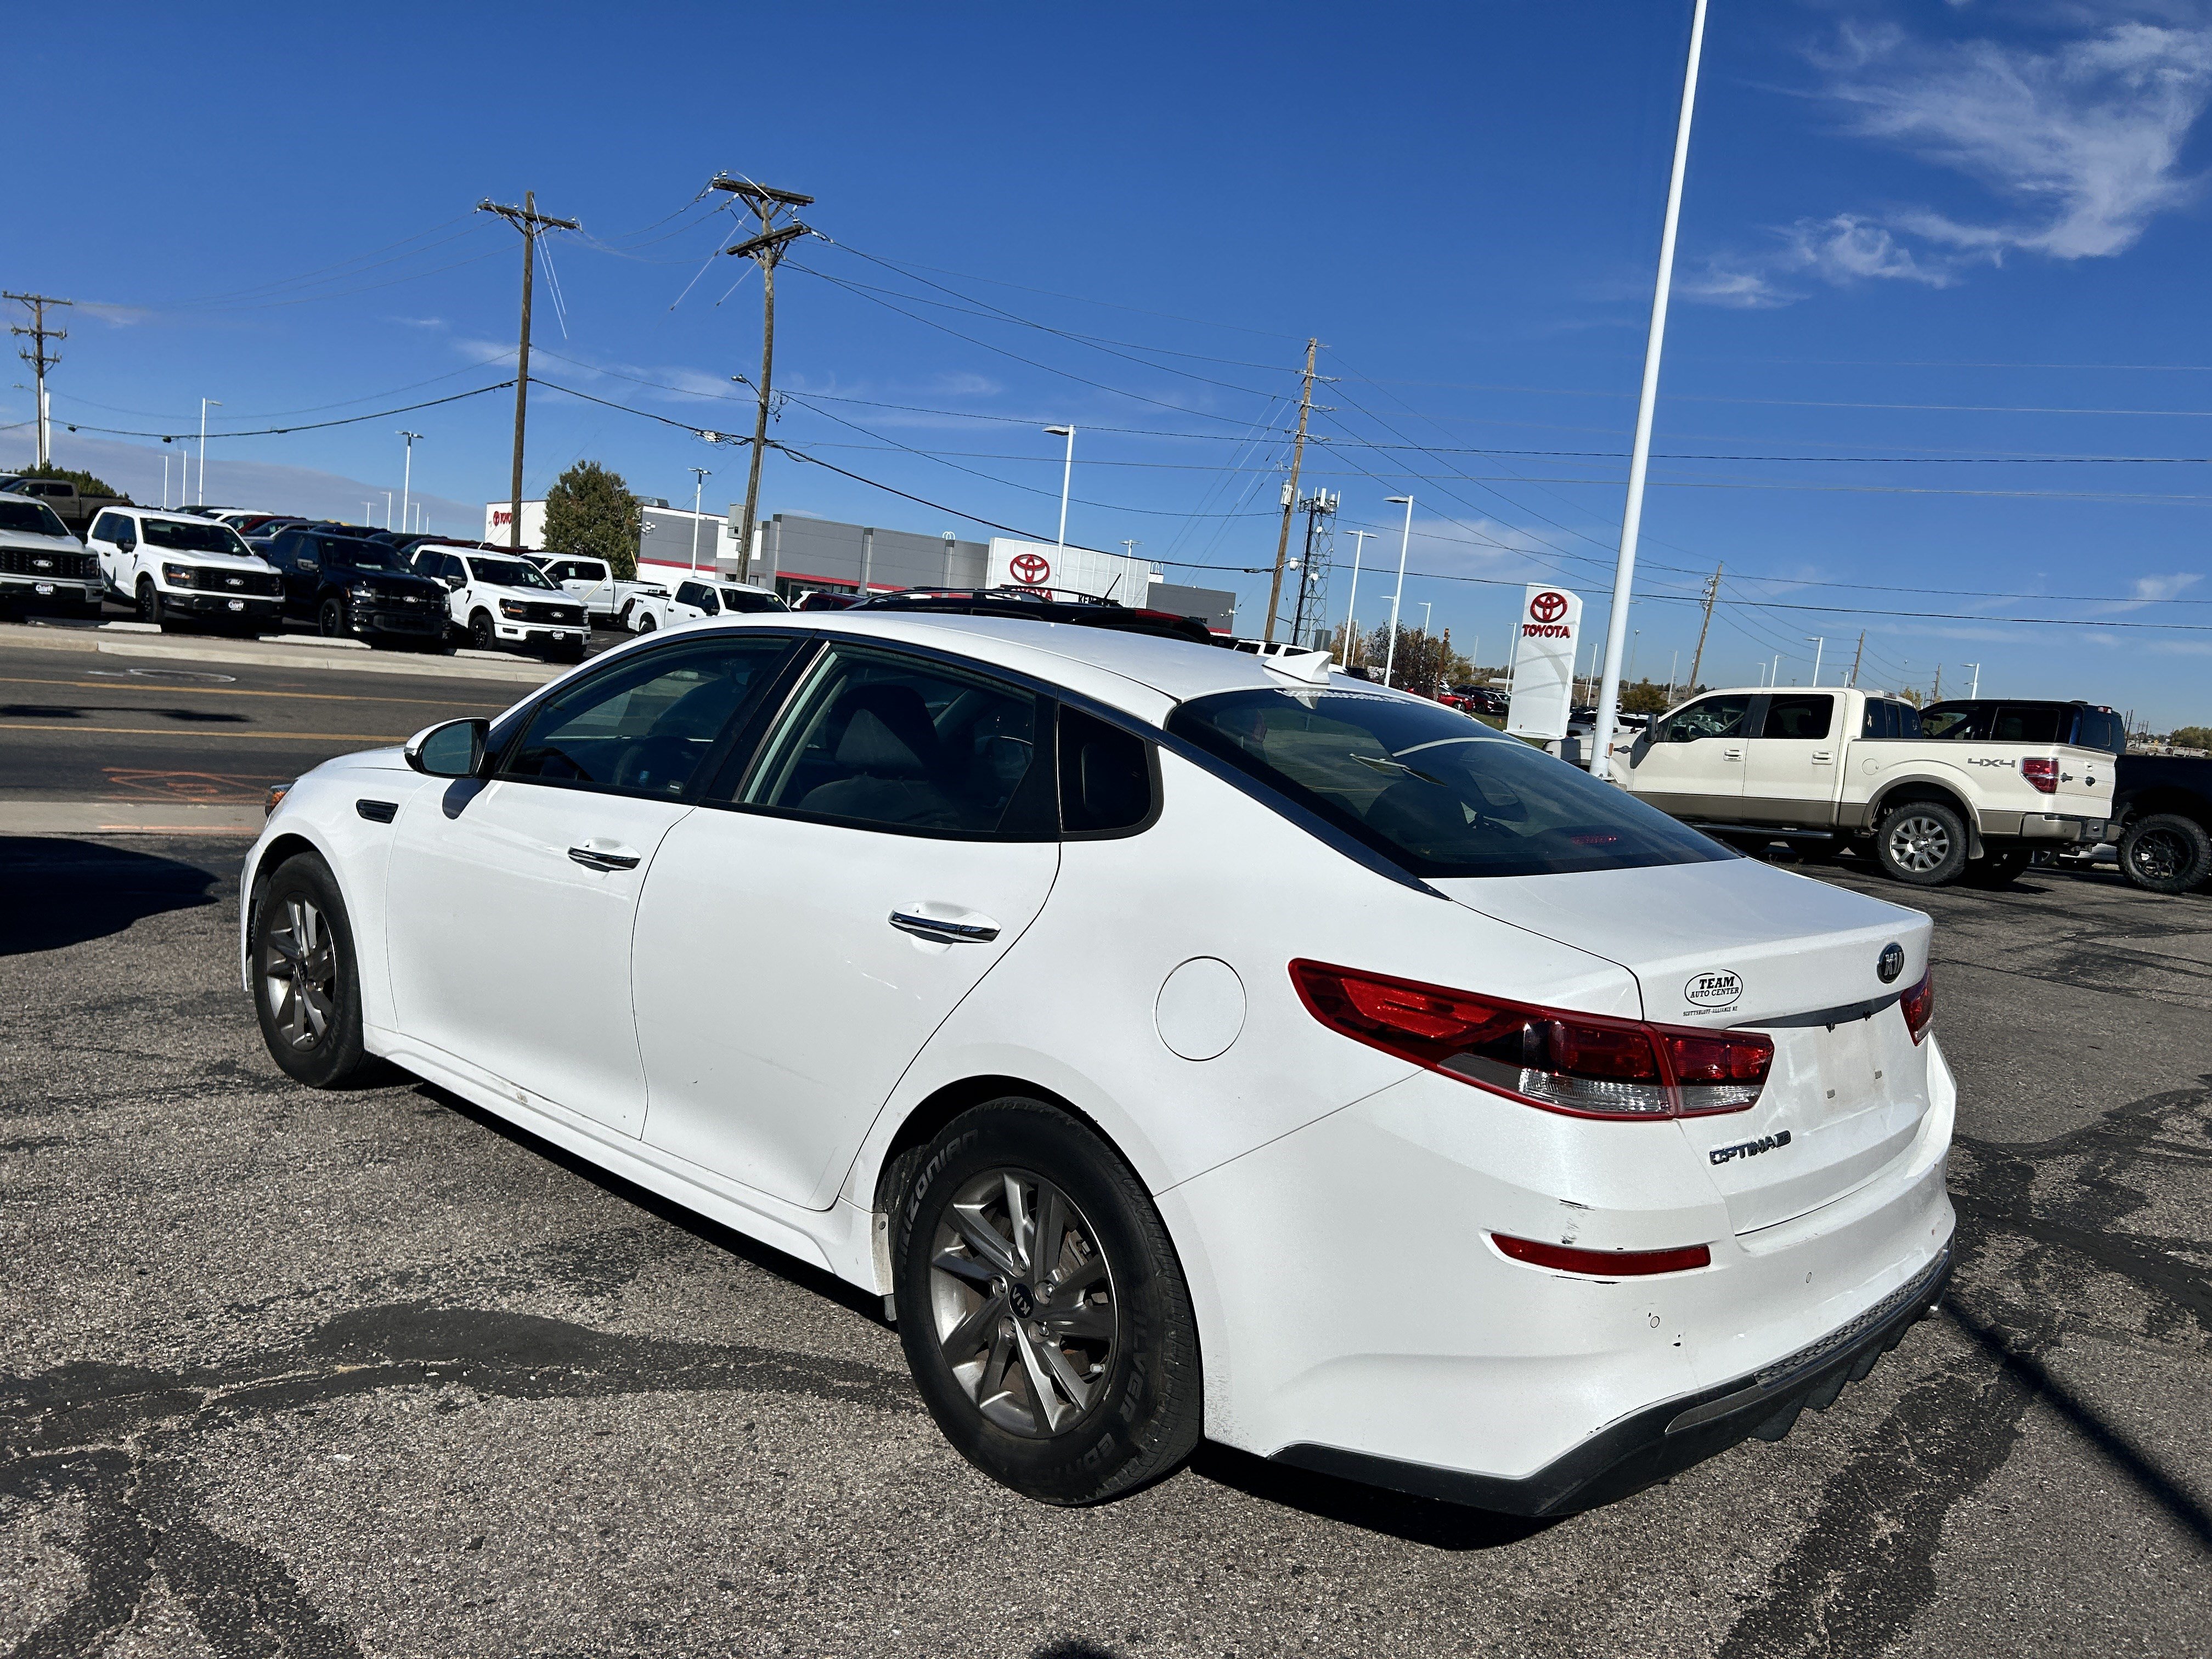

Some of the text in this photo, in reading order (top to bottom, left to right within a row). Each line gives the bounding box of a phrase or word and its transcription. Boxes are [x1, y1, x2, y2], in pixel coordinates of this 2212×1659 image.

[1522, 624, 1570, 639] TOYOTA
[1884, 951, 1903, 976] KIA
[1690, 987, 1739, 998] AUTO CENTER
[1699, 977, 1735, 989] TEAM
[1709, 1135, 1776, 1165] OPTIMA
[1012, 1286, 1030, 1316] KIA
